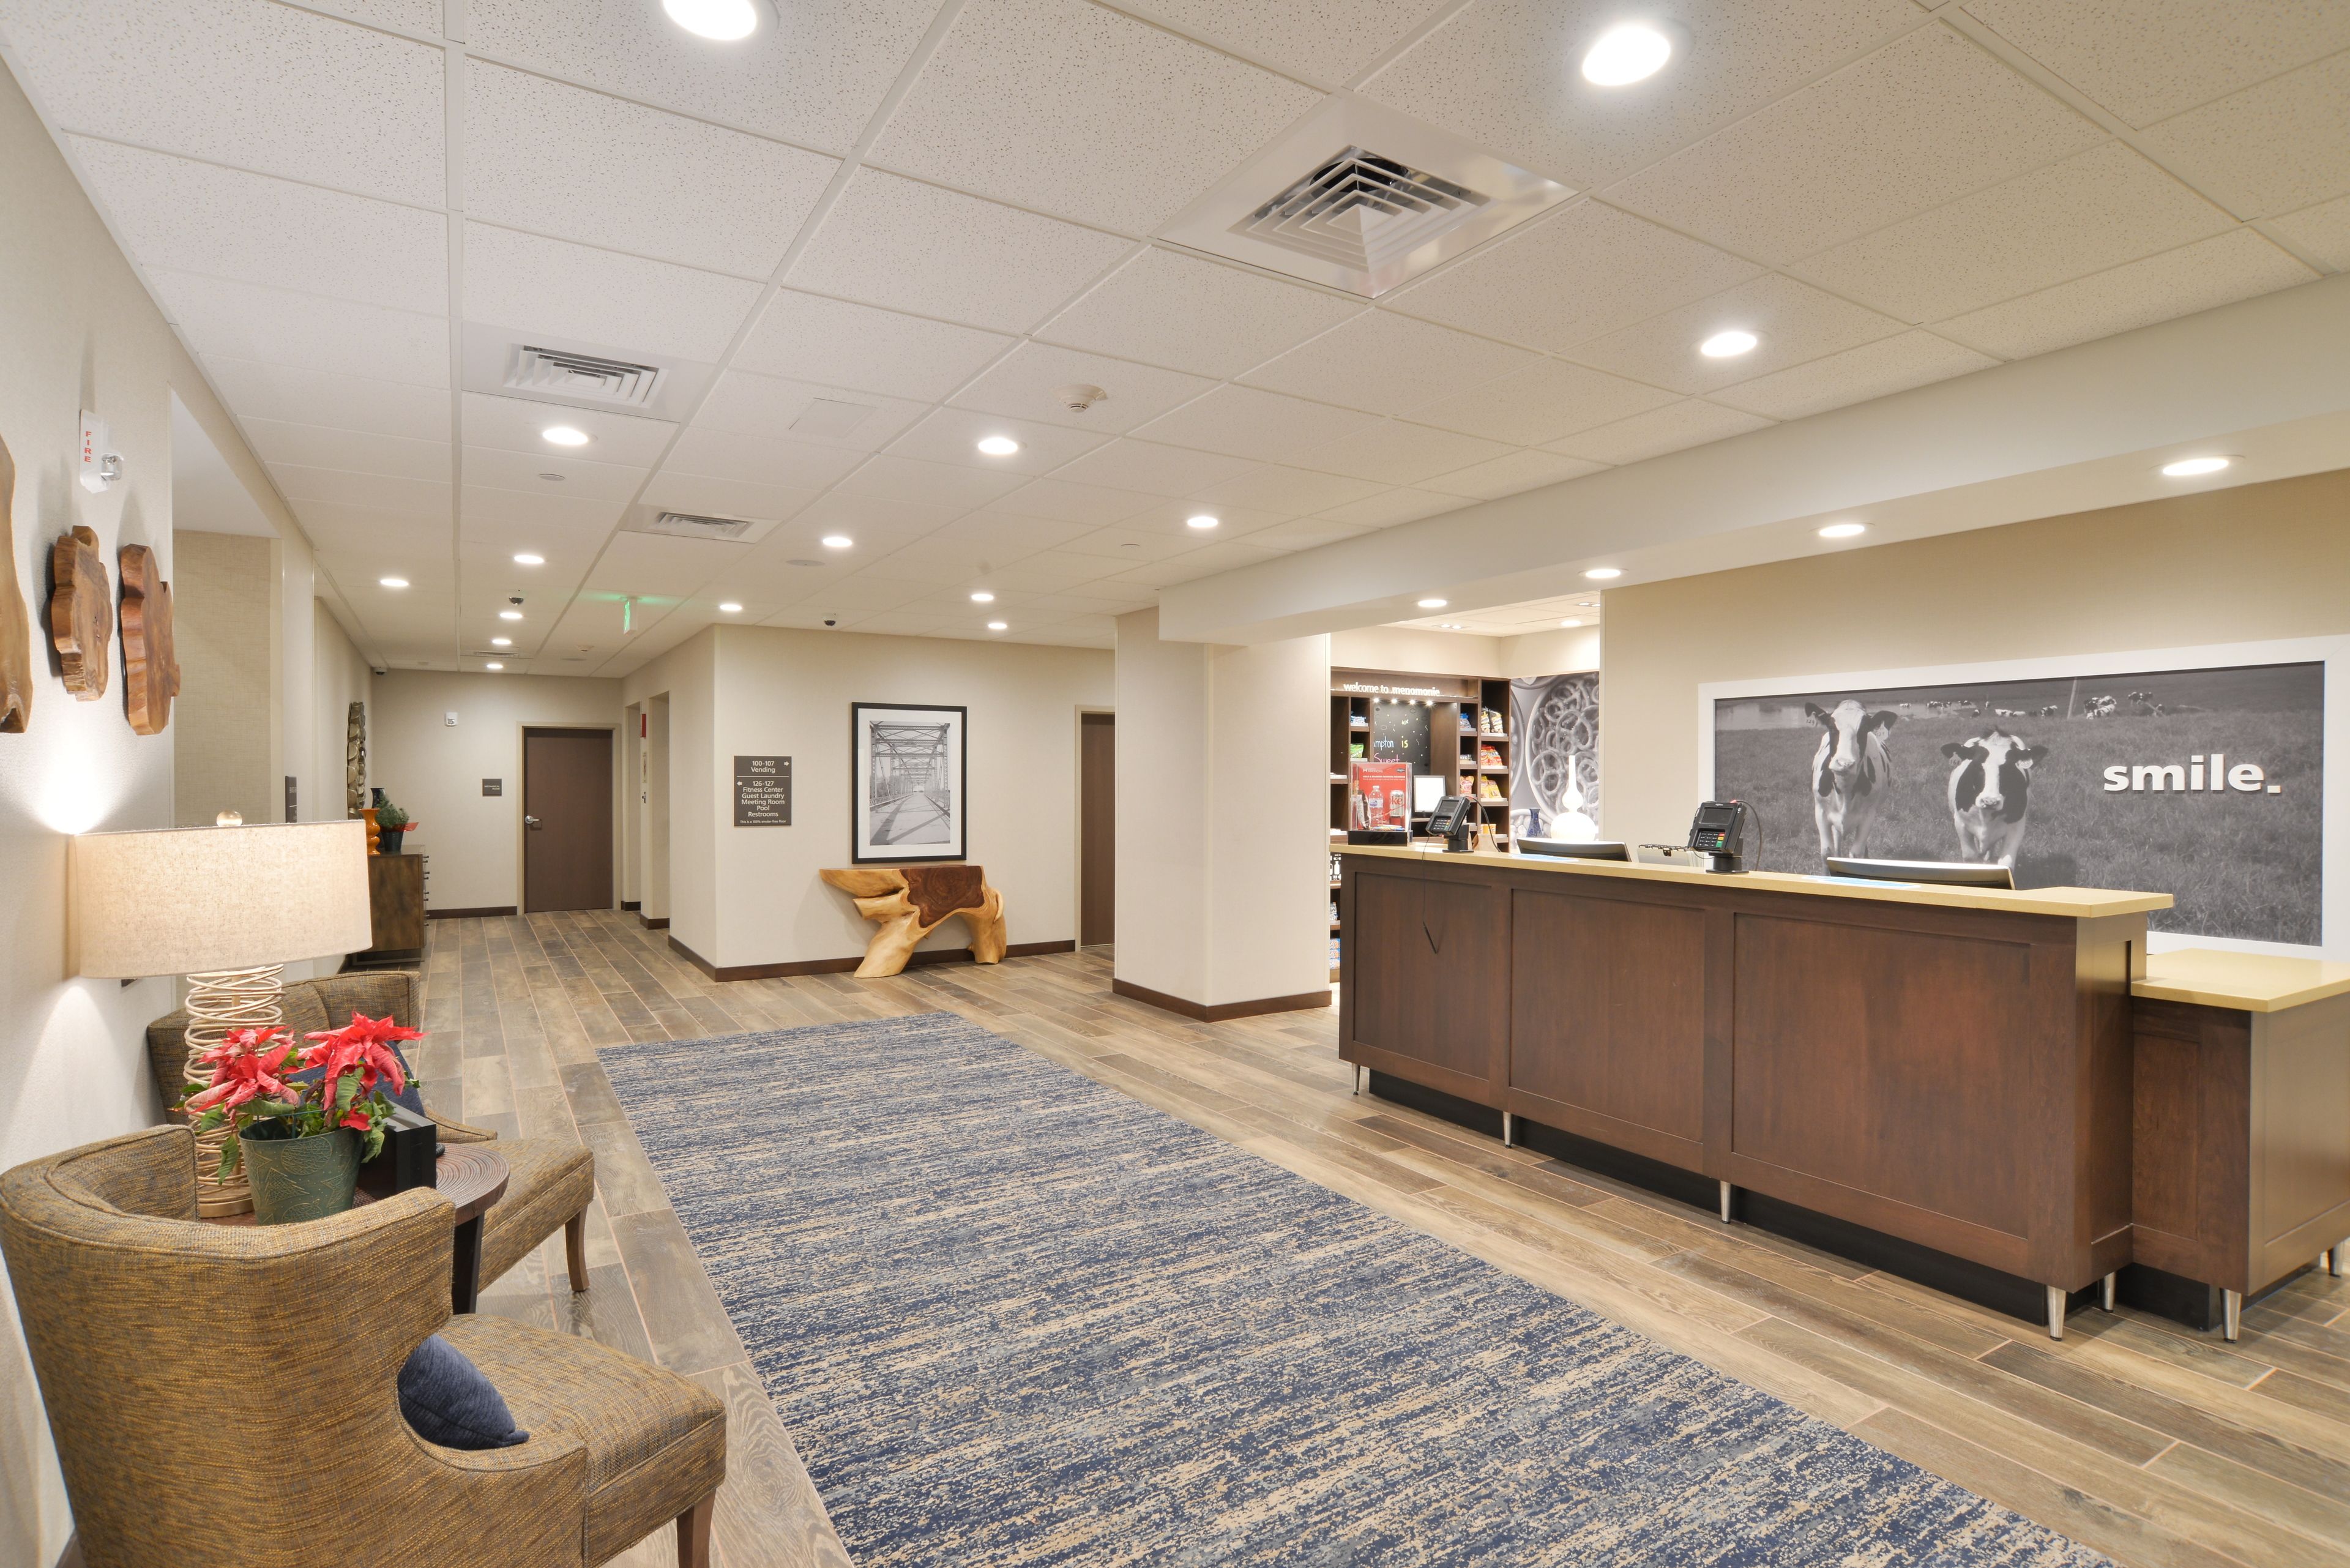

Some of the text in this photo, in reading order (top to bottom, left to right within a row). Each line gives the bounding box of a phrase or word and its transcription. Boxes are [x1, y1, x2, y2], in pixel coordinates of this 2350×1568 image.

[1343, 682, 1379, 693] welcome
[1381, 685, 1389, 694] to
[2103, 753, 2282, 794] smile.
